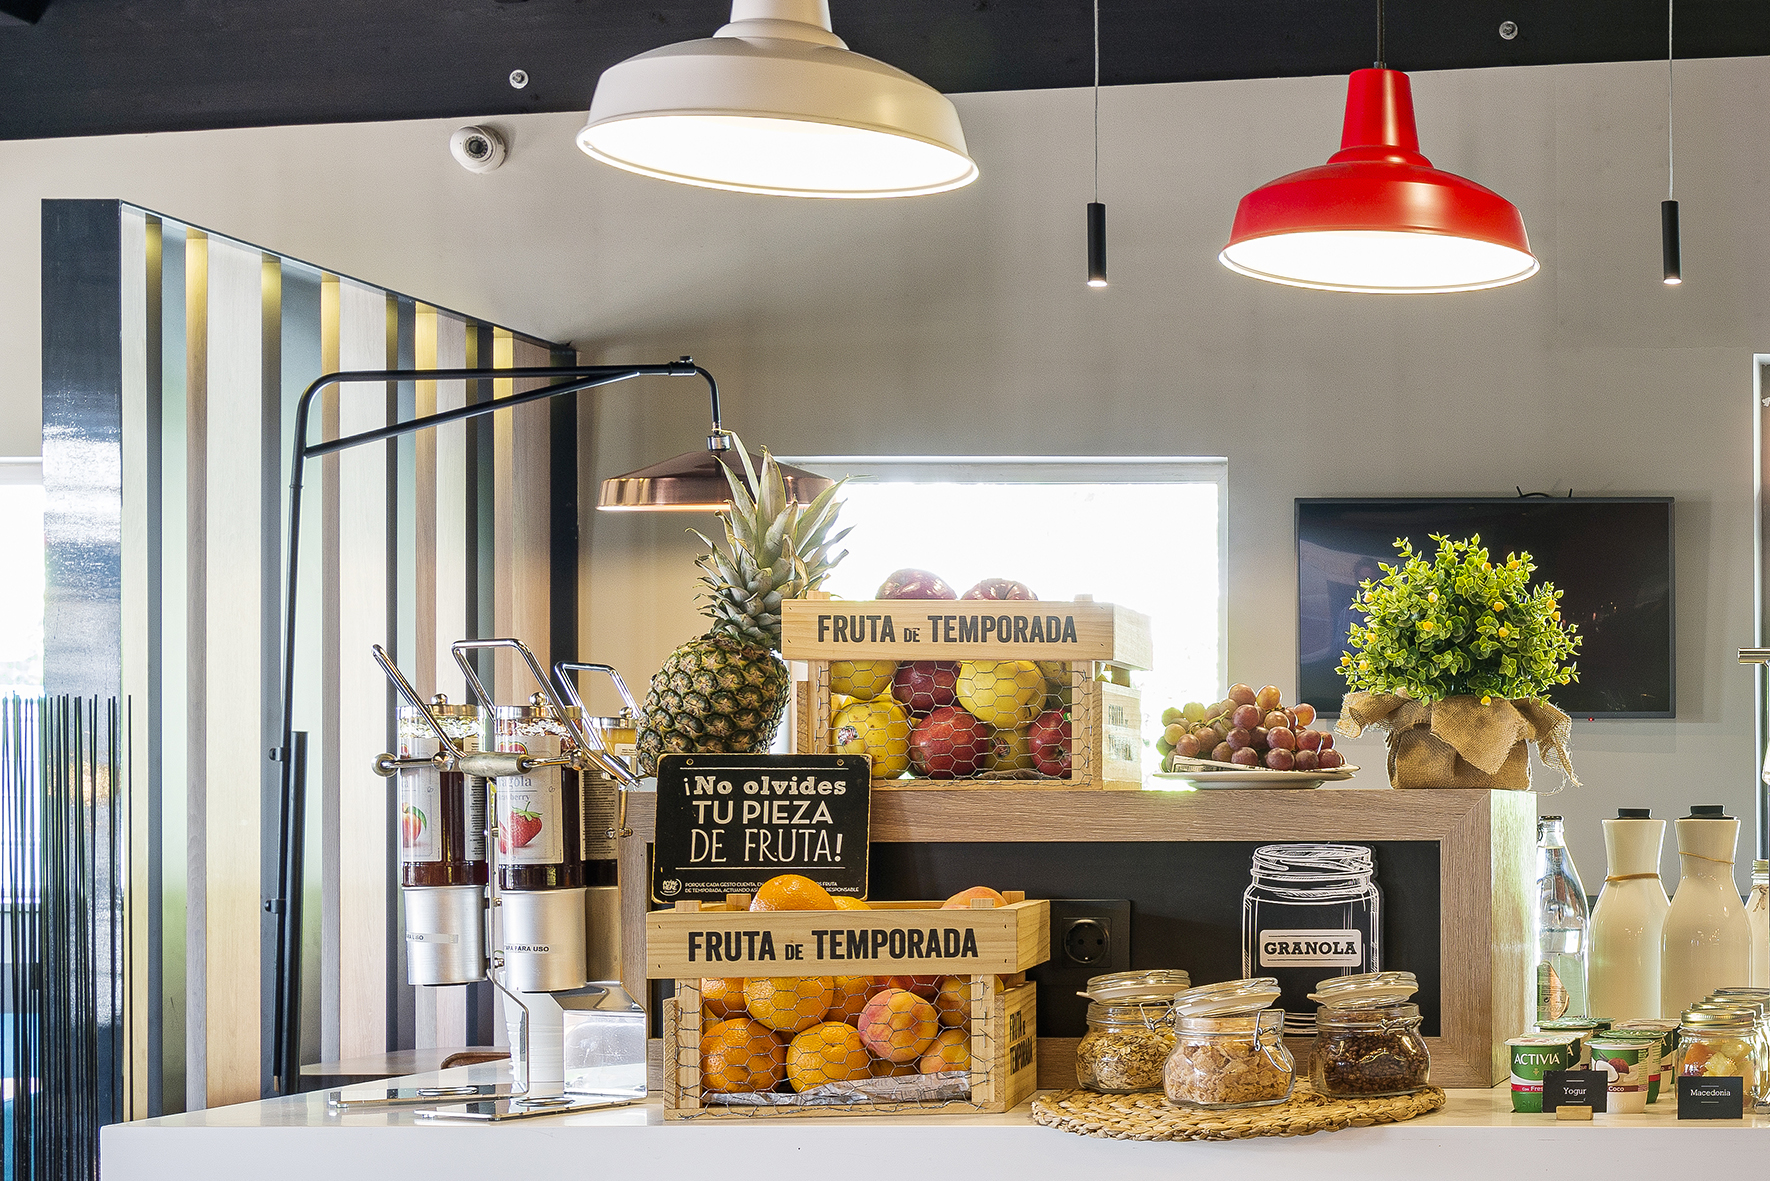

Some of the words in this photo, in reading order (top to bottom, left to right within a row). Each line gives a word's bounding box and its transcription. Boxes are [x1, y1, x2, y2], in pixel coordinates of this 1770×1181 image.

[817, 614, 896, 643] FRUTA
[903, 627, 921, 643] DE
[927, 615, 1078, 644] TEMPORADA
[683, 775, 733, 796] ¡No
[743, 775, 847, 796] olvides
[692, 800, 734, 825] TU
[742, 800, 834, 825] PIEZA
[689, 829, 727, 863] DE
[744, 828, 843, 863] FRUTA!
[688, 930, 777, 962] FRUTA
[784, 943, 804, 961] DE
[811, 927, 979, 961] TEMPORADA
[1263, 941, 1358, 956] GRANOLA
[1513, 1052, 1561, 1066] ACTIVIA
[1563, 1087, 1587, 1097] Yogur
[1690, 1088, 1731, 1097] Macedonia
